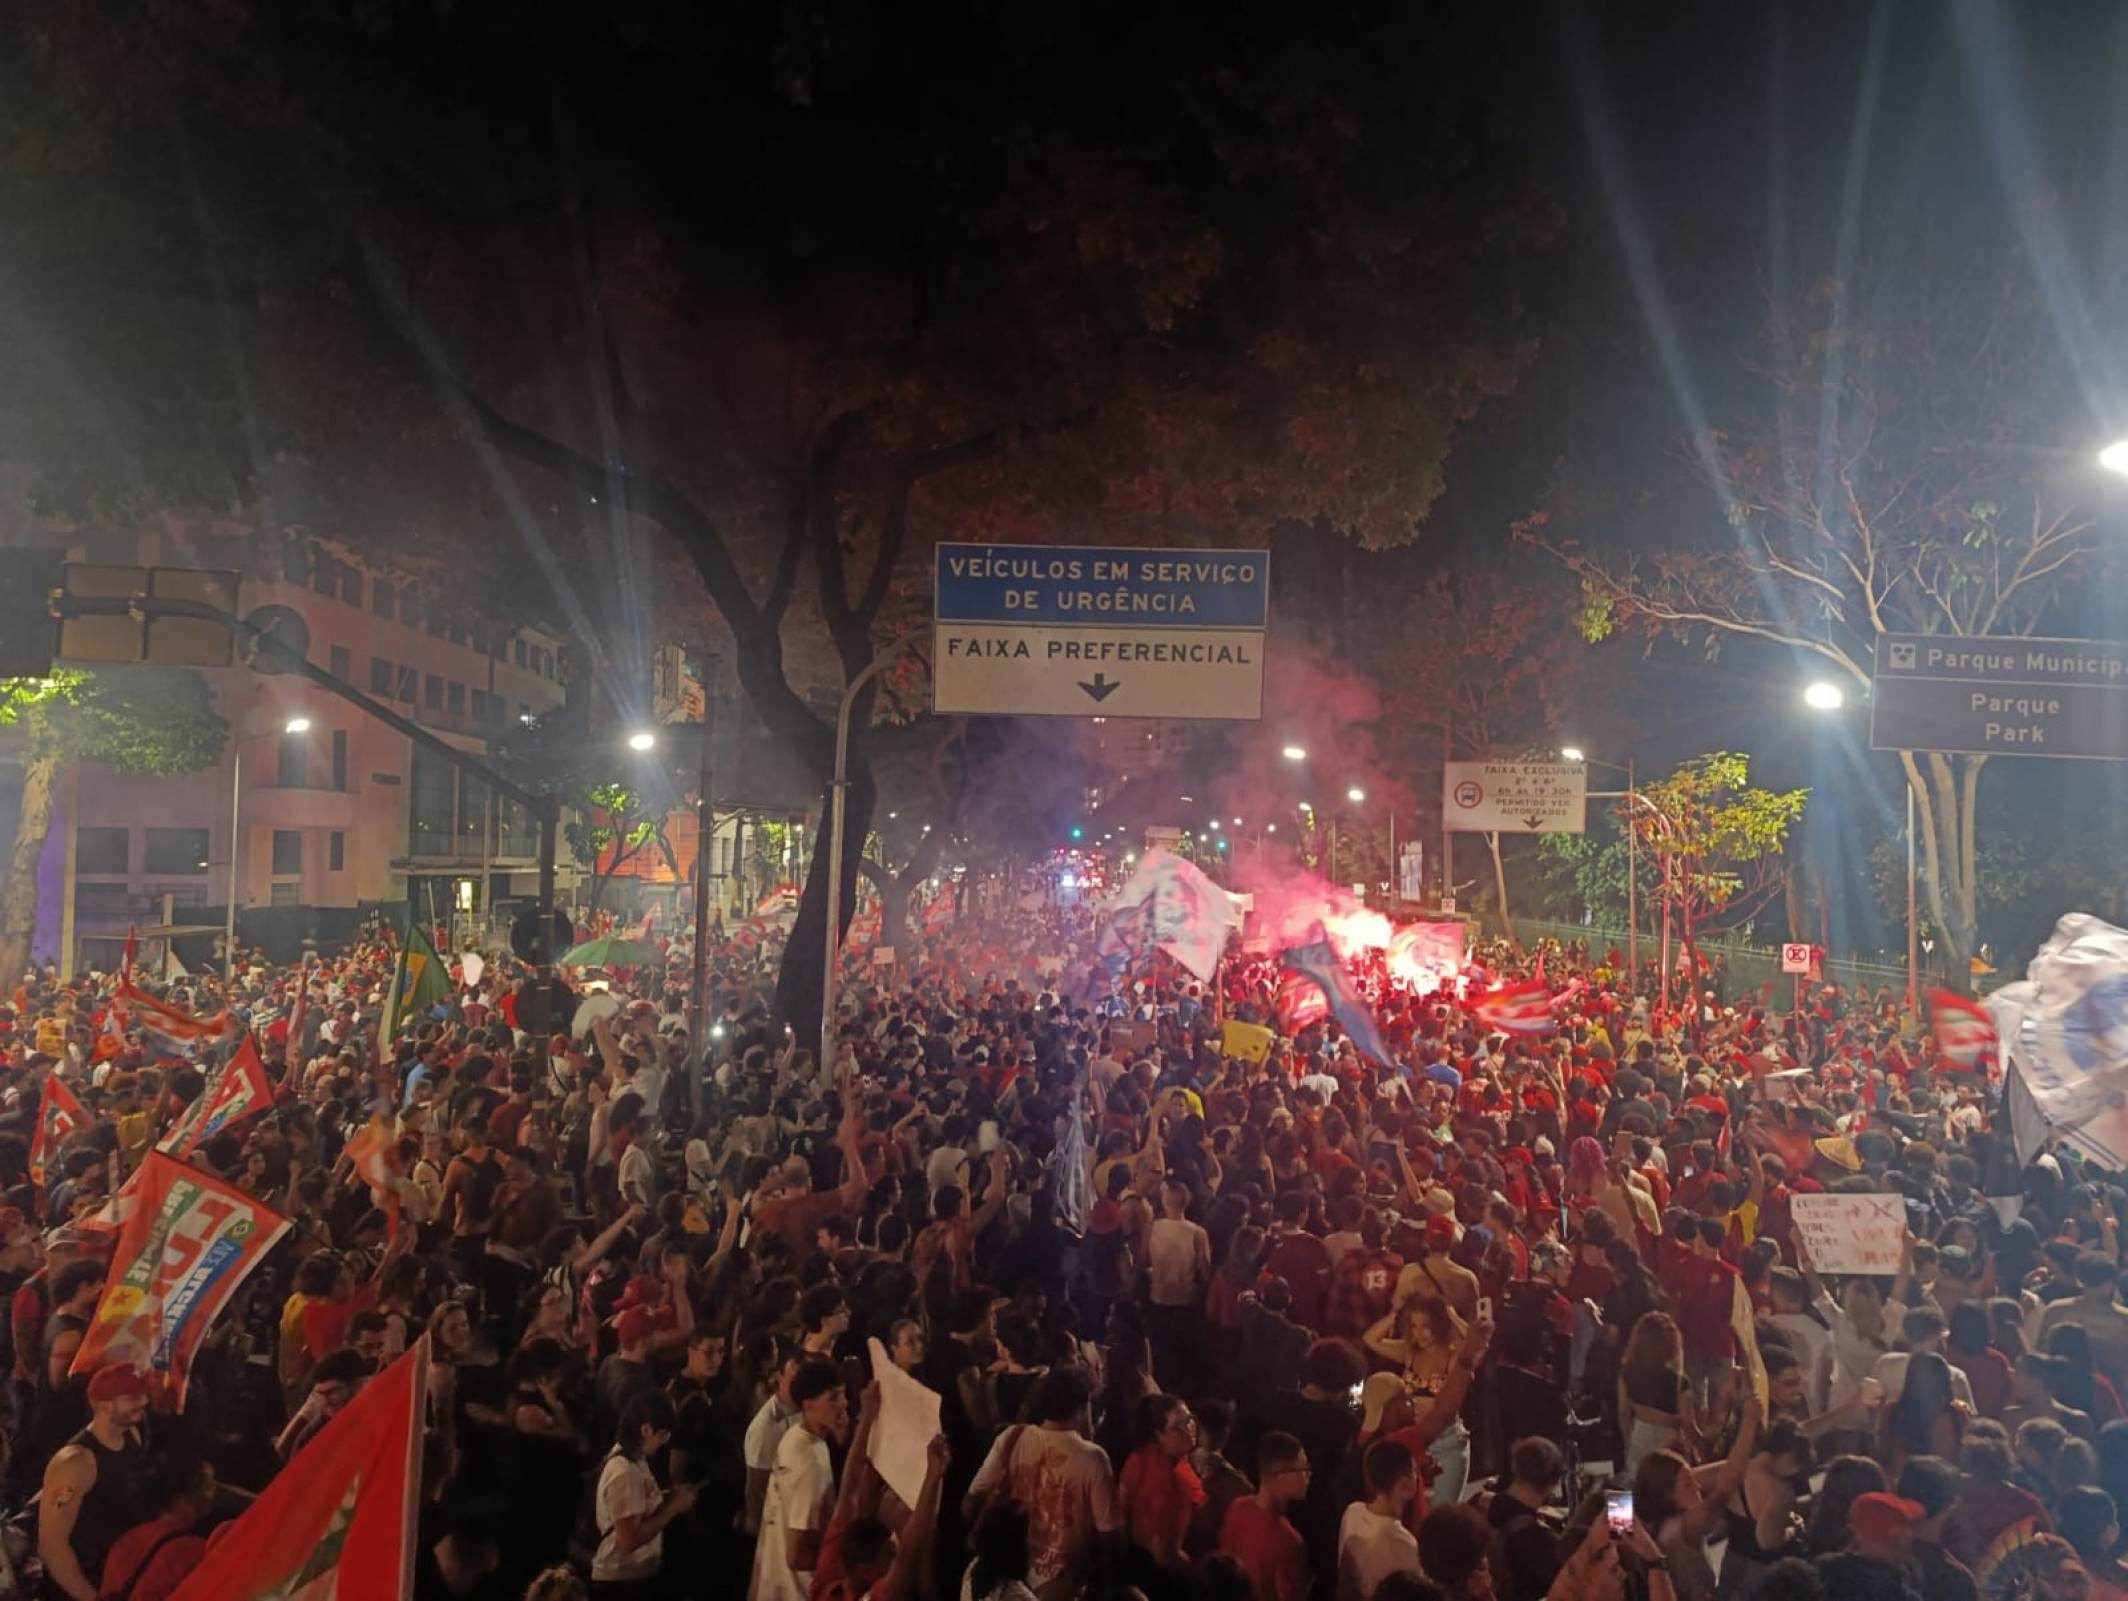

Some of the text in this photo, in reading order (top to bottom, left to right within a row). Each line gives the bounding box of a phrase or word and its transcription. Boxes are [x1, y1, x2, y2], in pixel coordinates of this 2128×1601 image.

[949, 549, 1256, 585] VEÍCULOS EM SERVIÇO
[1004, 587, 1197, 613] DE URGÊNCIA
[947, 637, 1251, 664] FAIXA PREFERENCIAL
[1927, 649, 2015, 673] Parque
[1971, 693, 2060, 716] Parque
[1986, 722, 2045, 743] Park
[1485, 765, 1584, 775] FAIXA EXCLUSIVA
